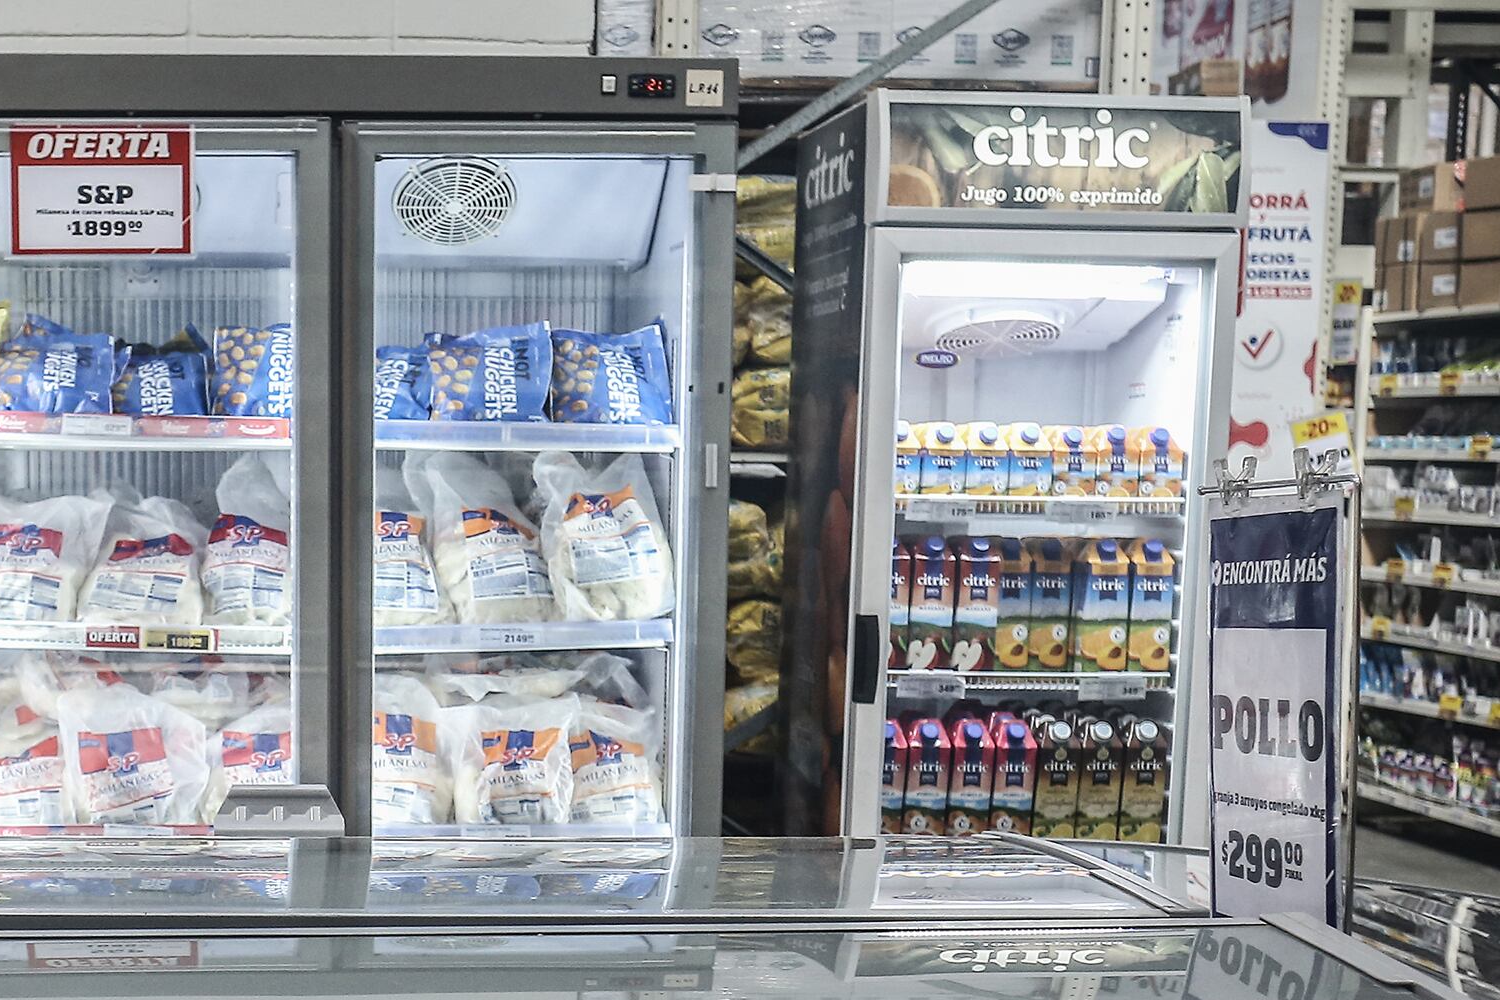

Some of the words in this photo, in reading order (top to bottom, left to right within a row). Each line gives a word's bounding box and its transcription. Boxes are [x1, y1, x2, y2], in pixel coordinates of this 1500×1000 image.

[27, 132, 170, 159] OFERTA
[973, 107, 1150, 168] citric
[805, 132, 854, 209] citric
[77, 185, 134, 205] S&P
[961, 186, 1008, 205] Jugo
[1013, 186, 1065, 203] 100%
[1069, 187, 1163, 207] exprimido
[267, 331, 284, 417] NUGGETS
[484, 347, 501, 419] NUGGETS
[500, 347, 517, 413] CHICKEN
[616, 351, 641, 417] CHICKEN
[599, 350, 626, 422] NUGGETS
[1222, 554, 1291, 585] ENCONTRÁ
[1293, 552, 1328, 583] MÁS
[916, 573, 950, 587] citric
[963, 573, 996, 588] citric
[1092, 577, 1125, 592] citric
[1136, 578, 1170, 592] citric
[88, 631, 137, 644] OFERTA
[1213, 694, 1324, 762] POLLO
[913, 760, 946, 773] citric
[957, 760, 989, 773] citric
[999, 760, 1031, 774] citric
[1044, 760, 1077, 772] citric
[1086, 760, 1119, 772] citric
[1130, 759, 1163, 771] citric
[1234, 793, 1240, 805] 3
[1240, 795, 1268, 811] arroyos
[1269, 800, 1310, 817] congelado
[1284, 841, 1303, 867] 00
